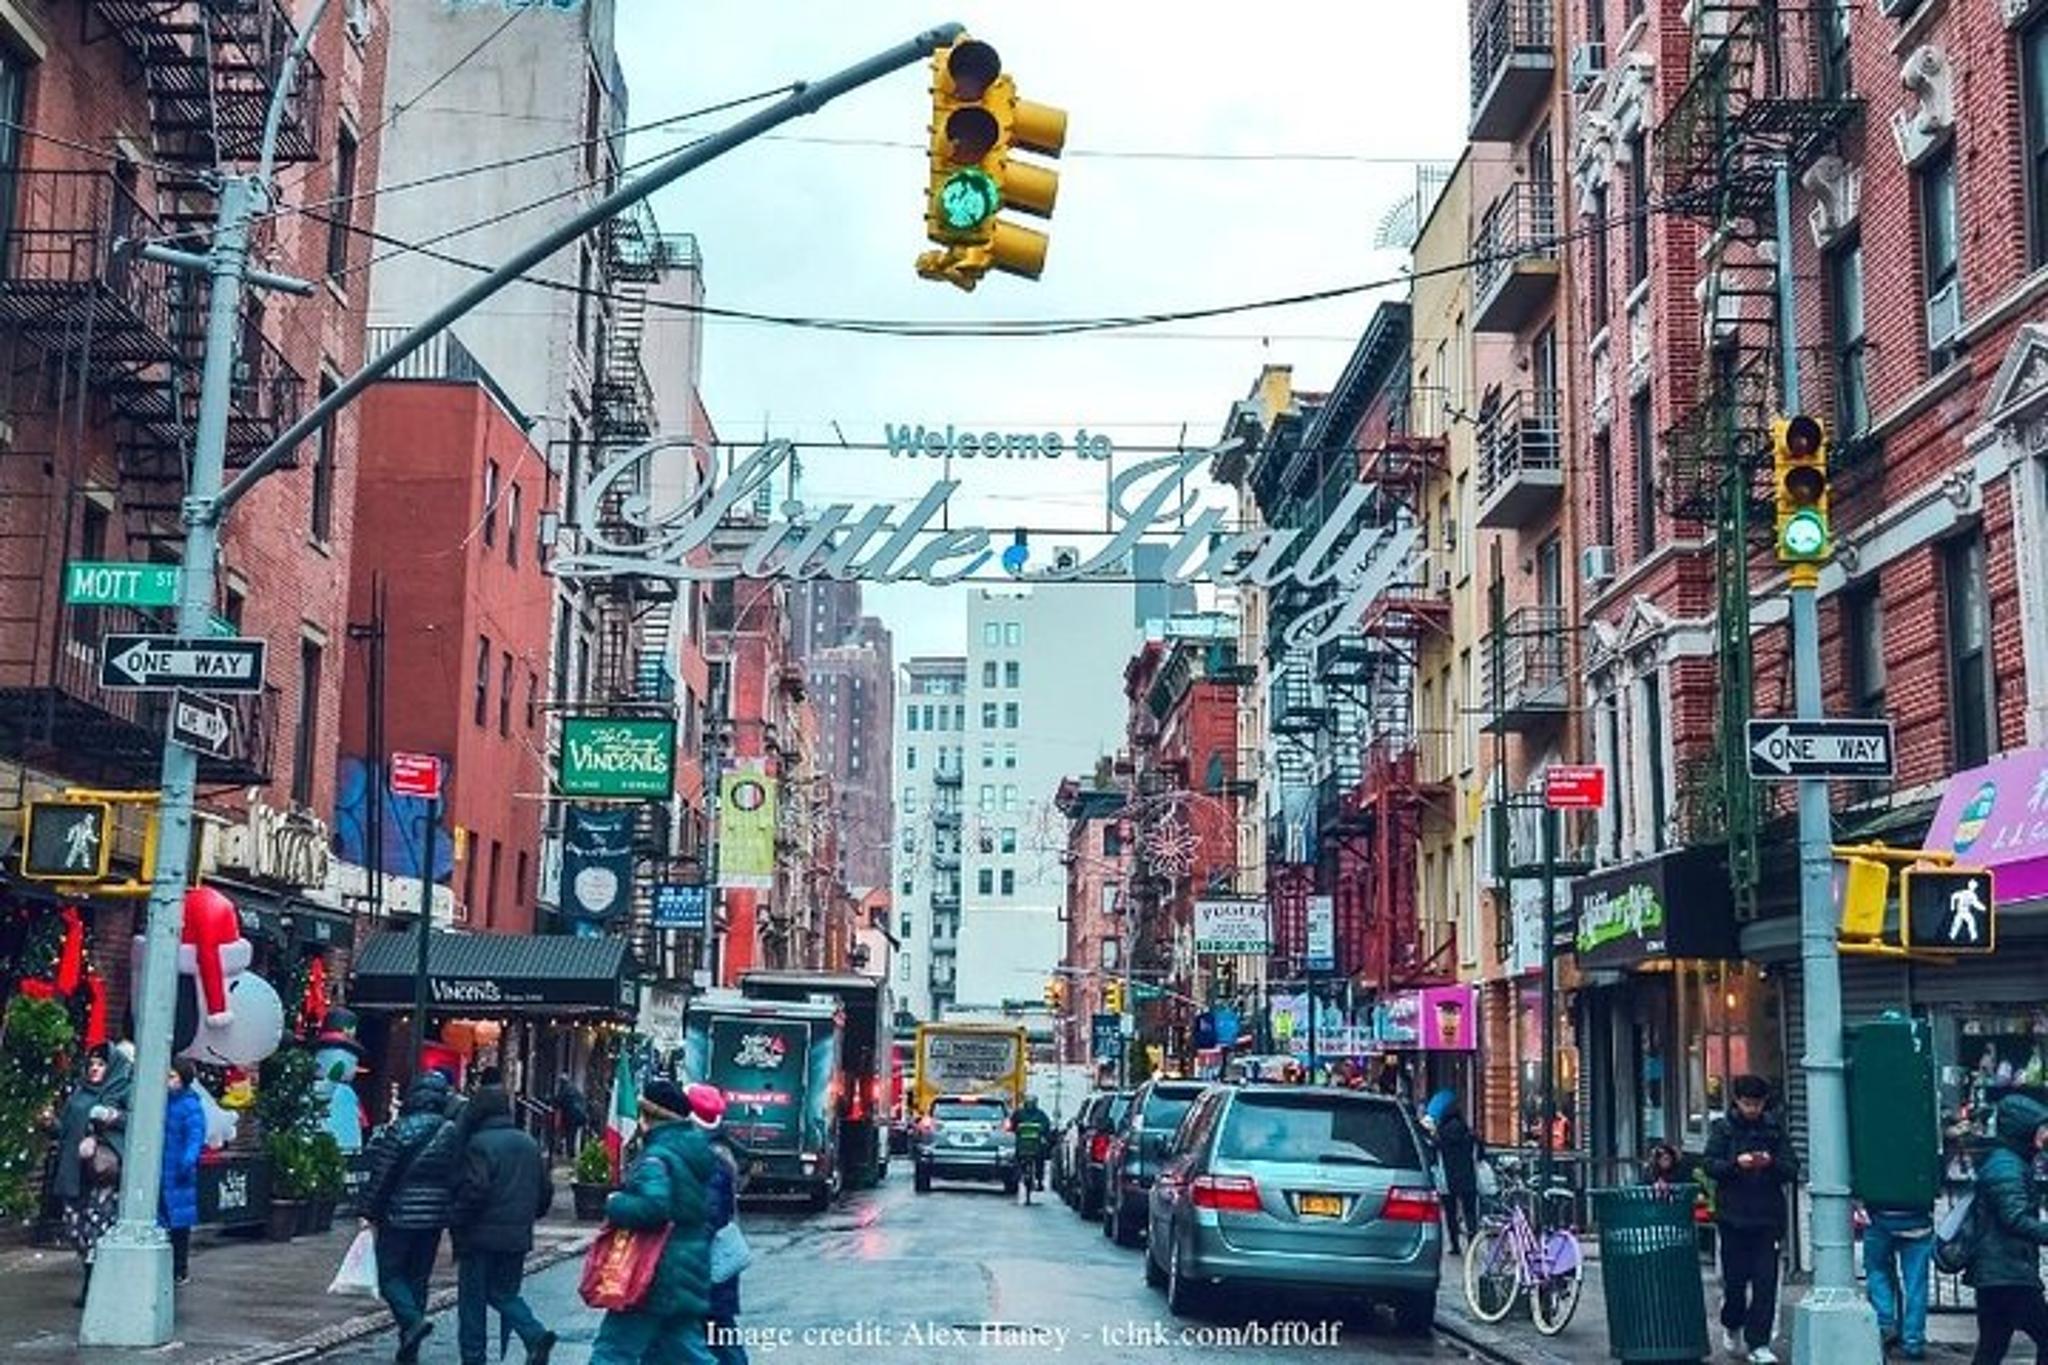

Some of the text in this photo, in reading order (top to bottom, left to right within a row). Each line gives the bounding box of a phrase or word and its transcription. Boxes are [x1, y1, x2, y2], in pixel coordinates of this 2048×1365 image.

[885, 423, 1113, 461] Welcome to
[549, 438, 1434, 648] Little Italy
[73, 568, 174, 599] MOTT ST
[127, 653, 242, 674] ONE WAY
[1769, 738, 1881, 760] ONE WAY
